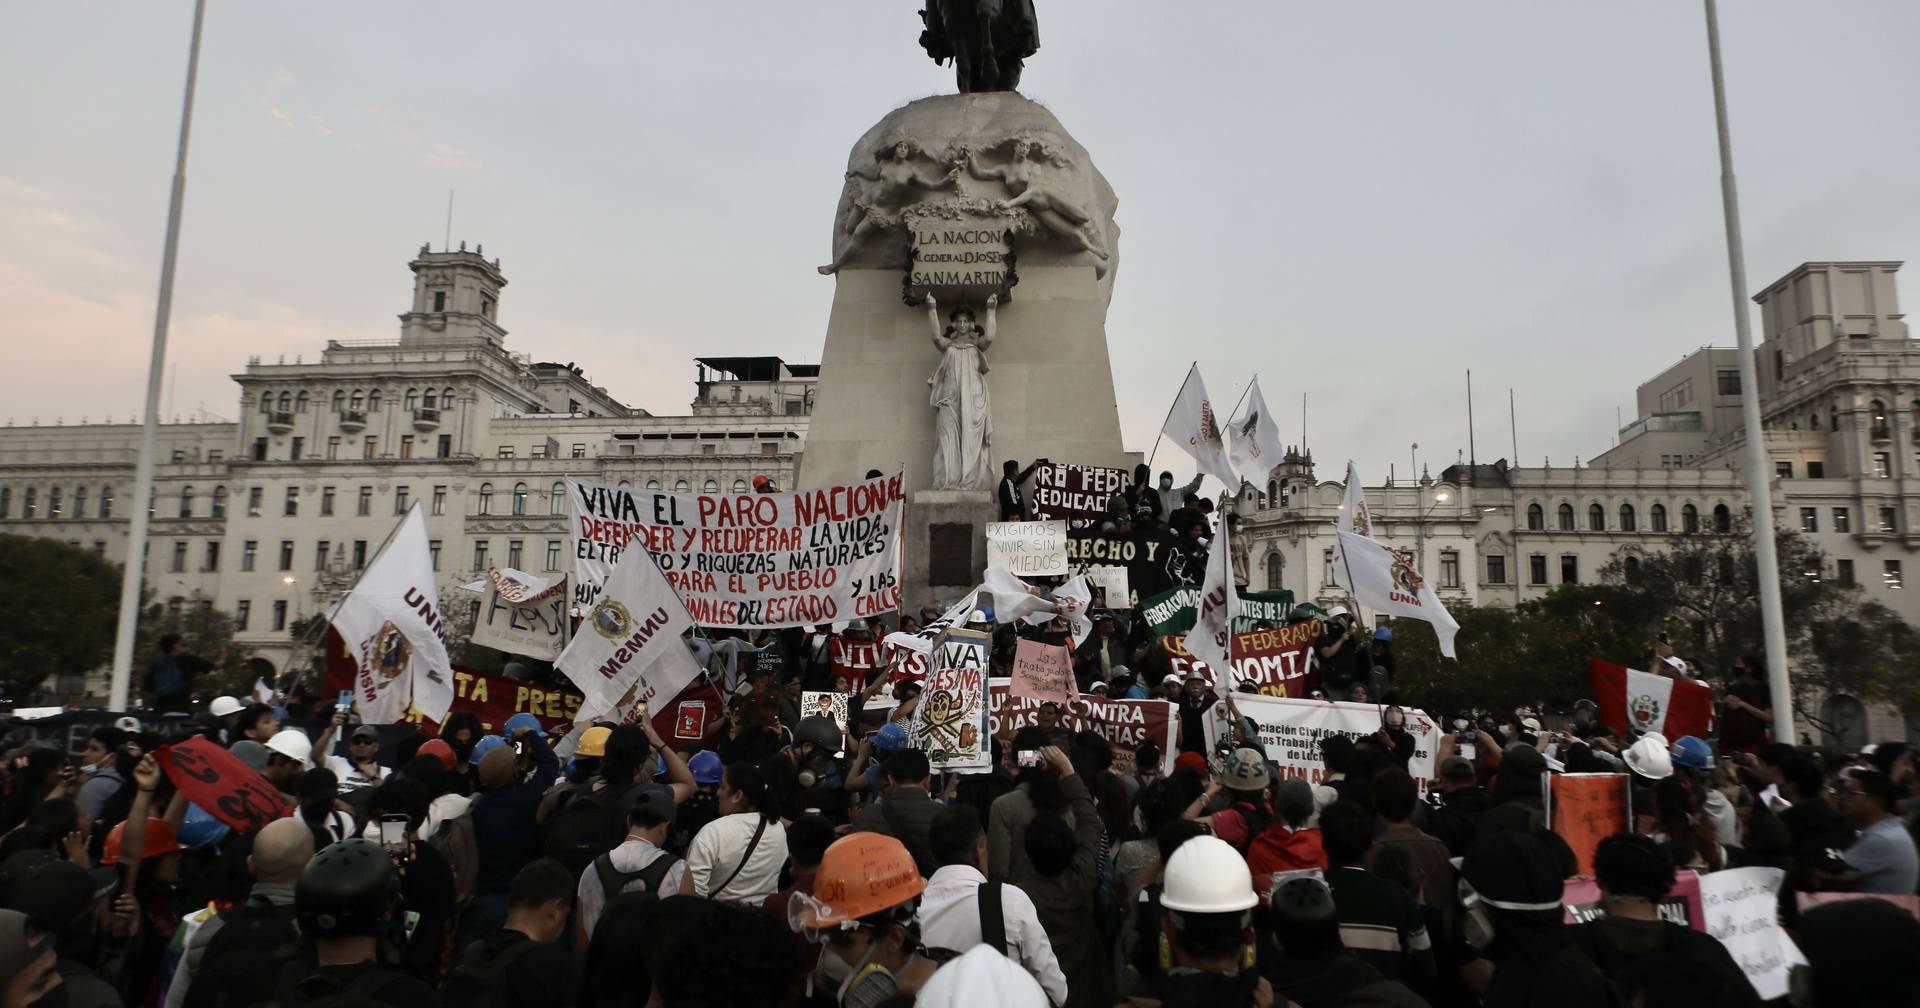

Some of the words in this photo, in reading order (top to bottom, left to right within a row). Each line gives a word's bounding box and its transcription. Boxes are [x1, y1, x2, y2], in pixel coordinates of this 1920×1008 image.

[919, 231, 940, 245] LA
[943, 230, 1001, 244] NACION
[578, 484, 640, 523] VIVA
[654, 494, 684, 526] EL
[697, 495, 778, 528] PARO
[580, 515, 676, 552] DEFENDER
[682, 527, 697, 553] Y
[701, 527, 802, 554] RECUPERAR
[810, 522, 832, 548] LA
[988, 522, 1057, 537] EXIGIMOS
[577, 539, 596, 560] EL
[995, 540, 1025, 553] VIVIR
[1033, 539, 1056, 551] SIN
[1066, 538, 1136, 561] RECHO
[1146, 541, 1160, 562] Y
[681, 553, 691, 570] Y
[697, 552, 776, 574] RIQUEZAS
[1008, 553, 1062, 573] MIEDOS
[666, 570, 717, 593] PARA
[728, 574, 746, 594] EL
[757, 567, 837, 592] PUEBLO
[851, 579, 862, 598] Y
[870, 568, 896, 592] LAS
[737, 600, 764, 626] DEL
[765, 594, 838, 624] ESTADO
[1238, 618, 1321, 653] FEDERADO
[1171, 645, 1320, 686] ENOMIA
[1256, 723, 1297, 736] ciación
